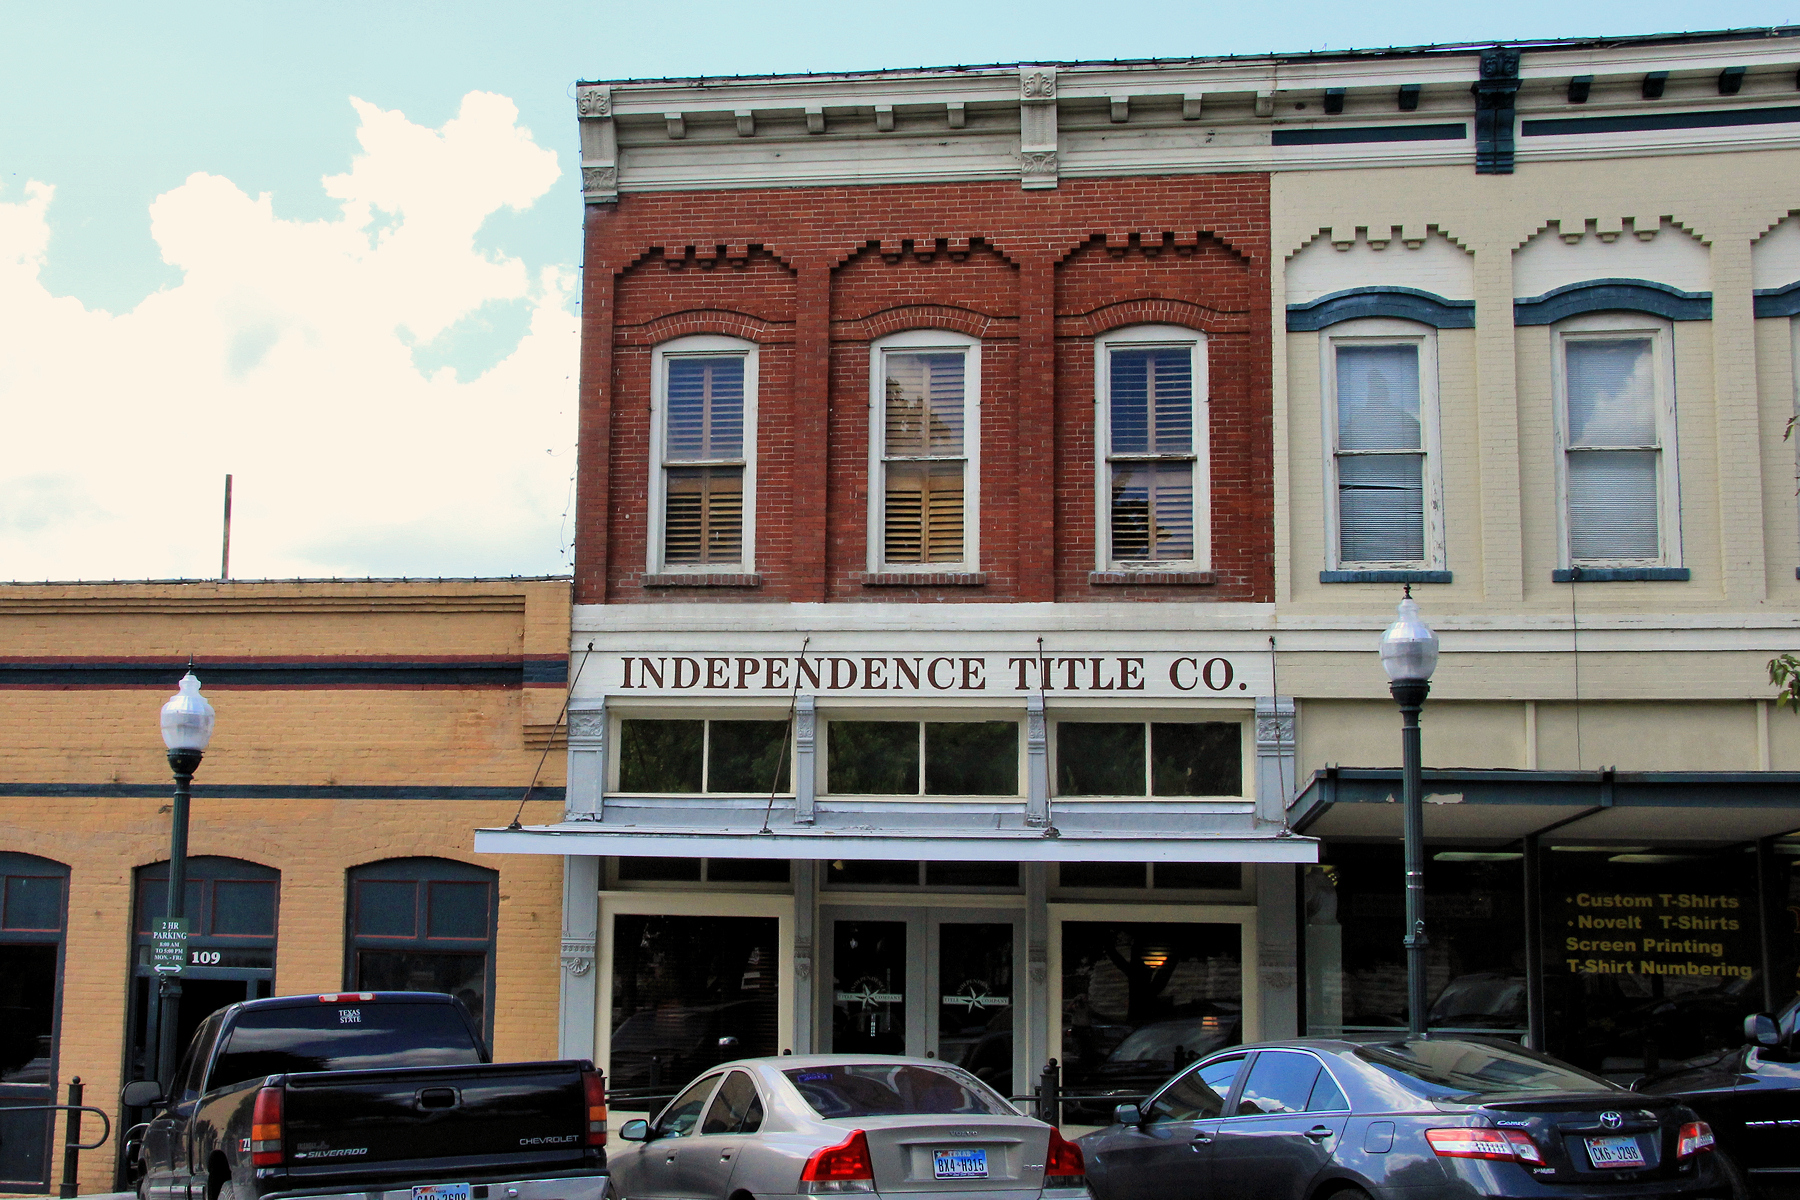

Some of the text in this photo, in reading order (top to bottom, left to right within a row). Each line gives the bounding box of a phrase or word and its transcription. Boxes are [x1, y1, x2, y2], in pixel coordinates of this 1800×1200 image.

[621, 656, 1248, 693] INDEPENDENCE TITLE CO.
[1576, 893, 1740, 909] Custom T-Shirts
[162, 922, 179, 930] 2 HR
[1578, 915, 1740, 931] Novelt T-Shirts
[153, 931, 187, 940] PARKING
[1566, 937, 1723, 957] Screen Printing
[192, 951, 221, 965] 109
[1566, 959, 1753, 980] T-Shirt Numbering
[338, 1009, 361, 1017] TEXAS
[519, 1135, 579, 1146] CHEVROLET
[949, 1130, 978, 1138] VOLVO
[307, 1147, 368, 1159] SILVERADO
